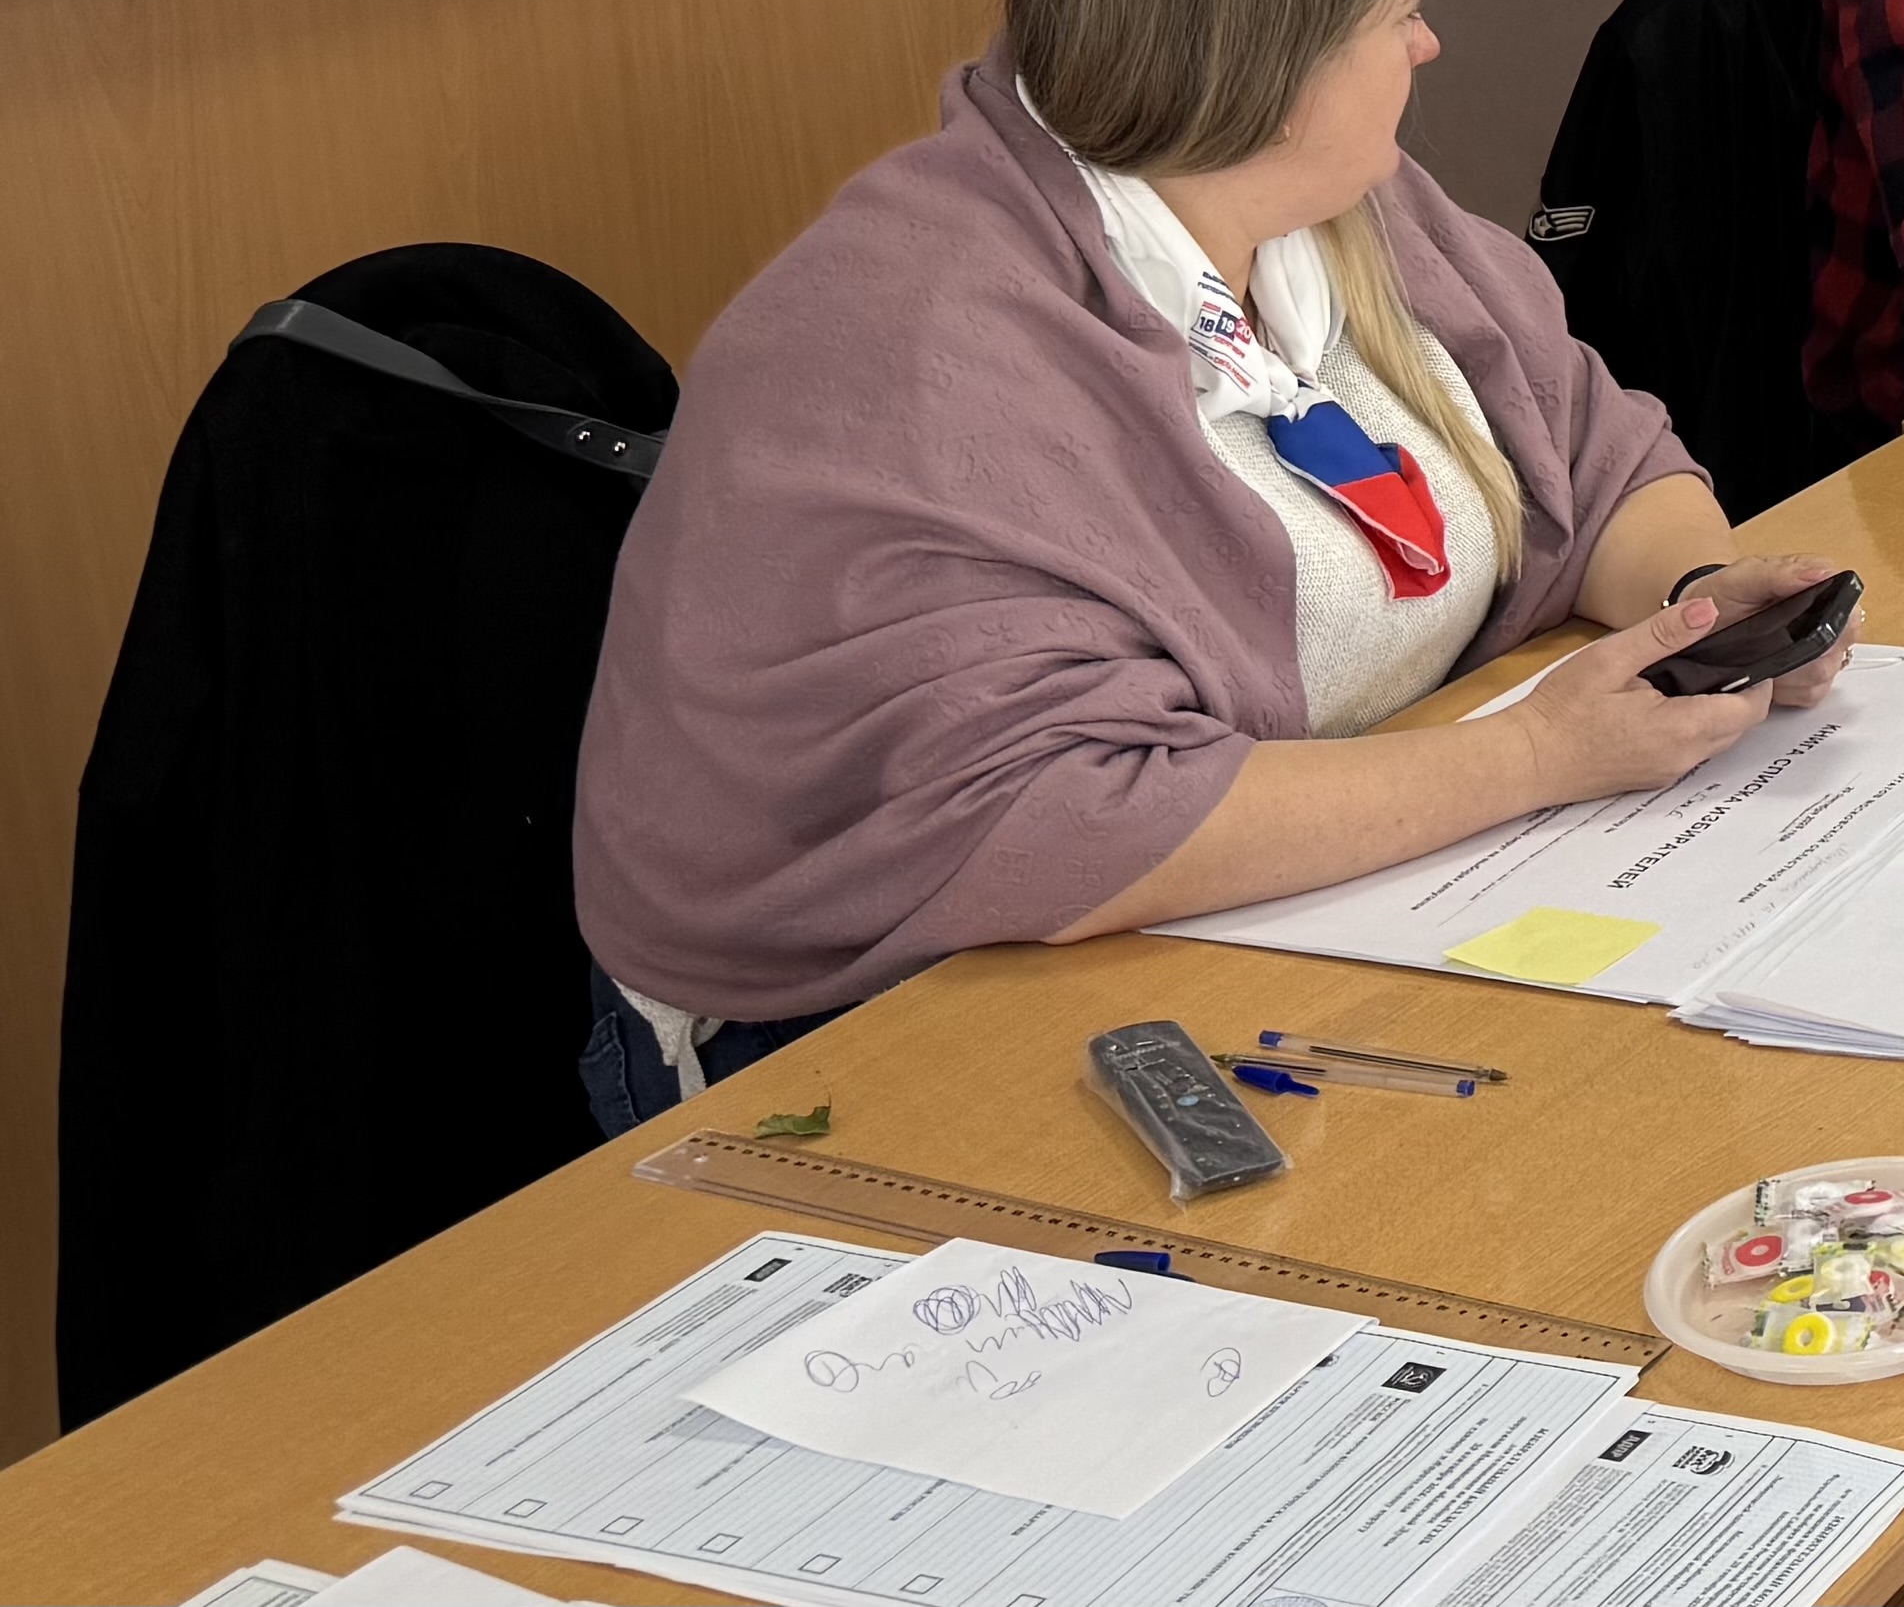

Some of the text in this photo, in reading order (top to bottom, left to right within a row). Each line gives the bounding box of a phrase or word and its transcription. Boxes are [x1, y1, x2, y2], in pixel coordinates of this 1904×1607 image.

[1200, 316, 1216, 334] 18
[1220, 316, 1236, 334] 19
[1607, 723, 1842, 890] КНИГА СПИСКА ИЗБИРАТЕЛЕЙ
[1611, 1433, 1645, 1458] ЛДПР
